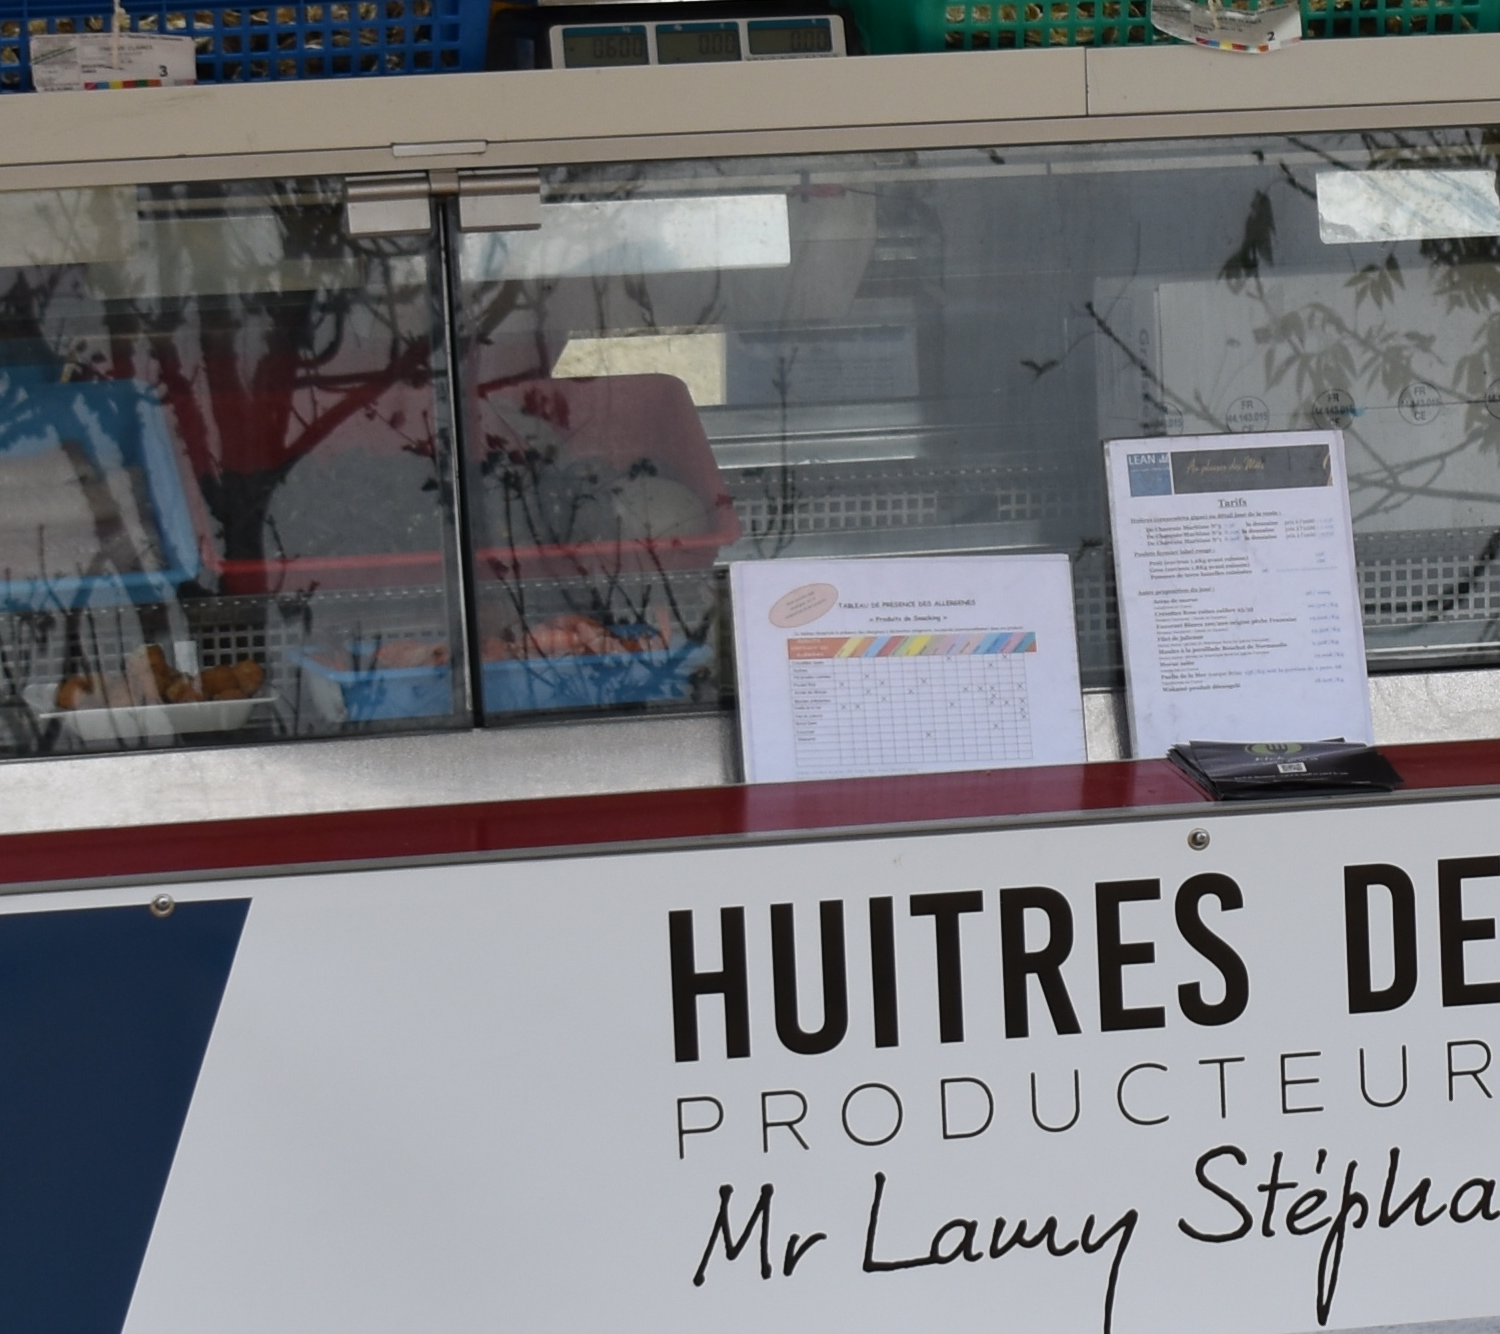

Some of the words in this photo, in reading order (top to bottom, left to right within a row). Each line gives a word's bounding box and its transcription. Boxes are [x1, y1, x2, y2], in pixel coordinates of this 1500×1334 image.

[1267, 32, 1275, 41] 2
[159, 65, 168, 77] 3
[1128, 454, 1155, 465] LEAN
[1218, 498, 1247, 509] Tarifs
[934, 599, 976, 607] ALLERGENES
[668, 872, 1251, 1063] HUITRES
[678, 1039, 1494, 1159] PRODUCTEUR
[693, 1182, 826, 1286] Mr
